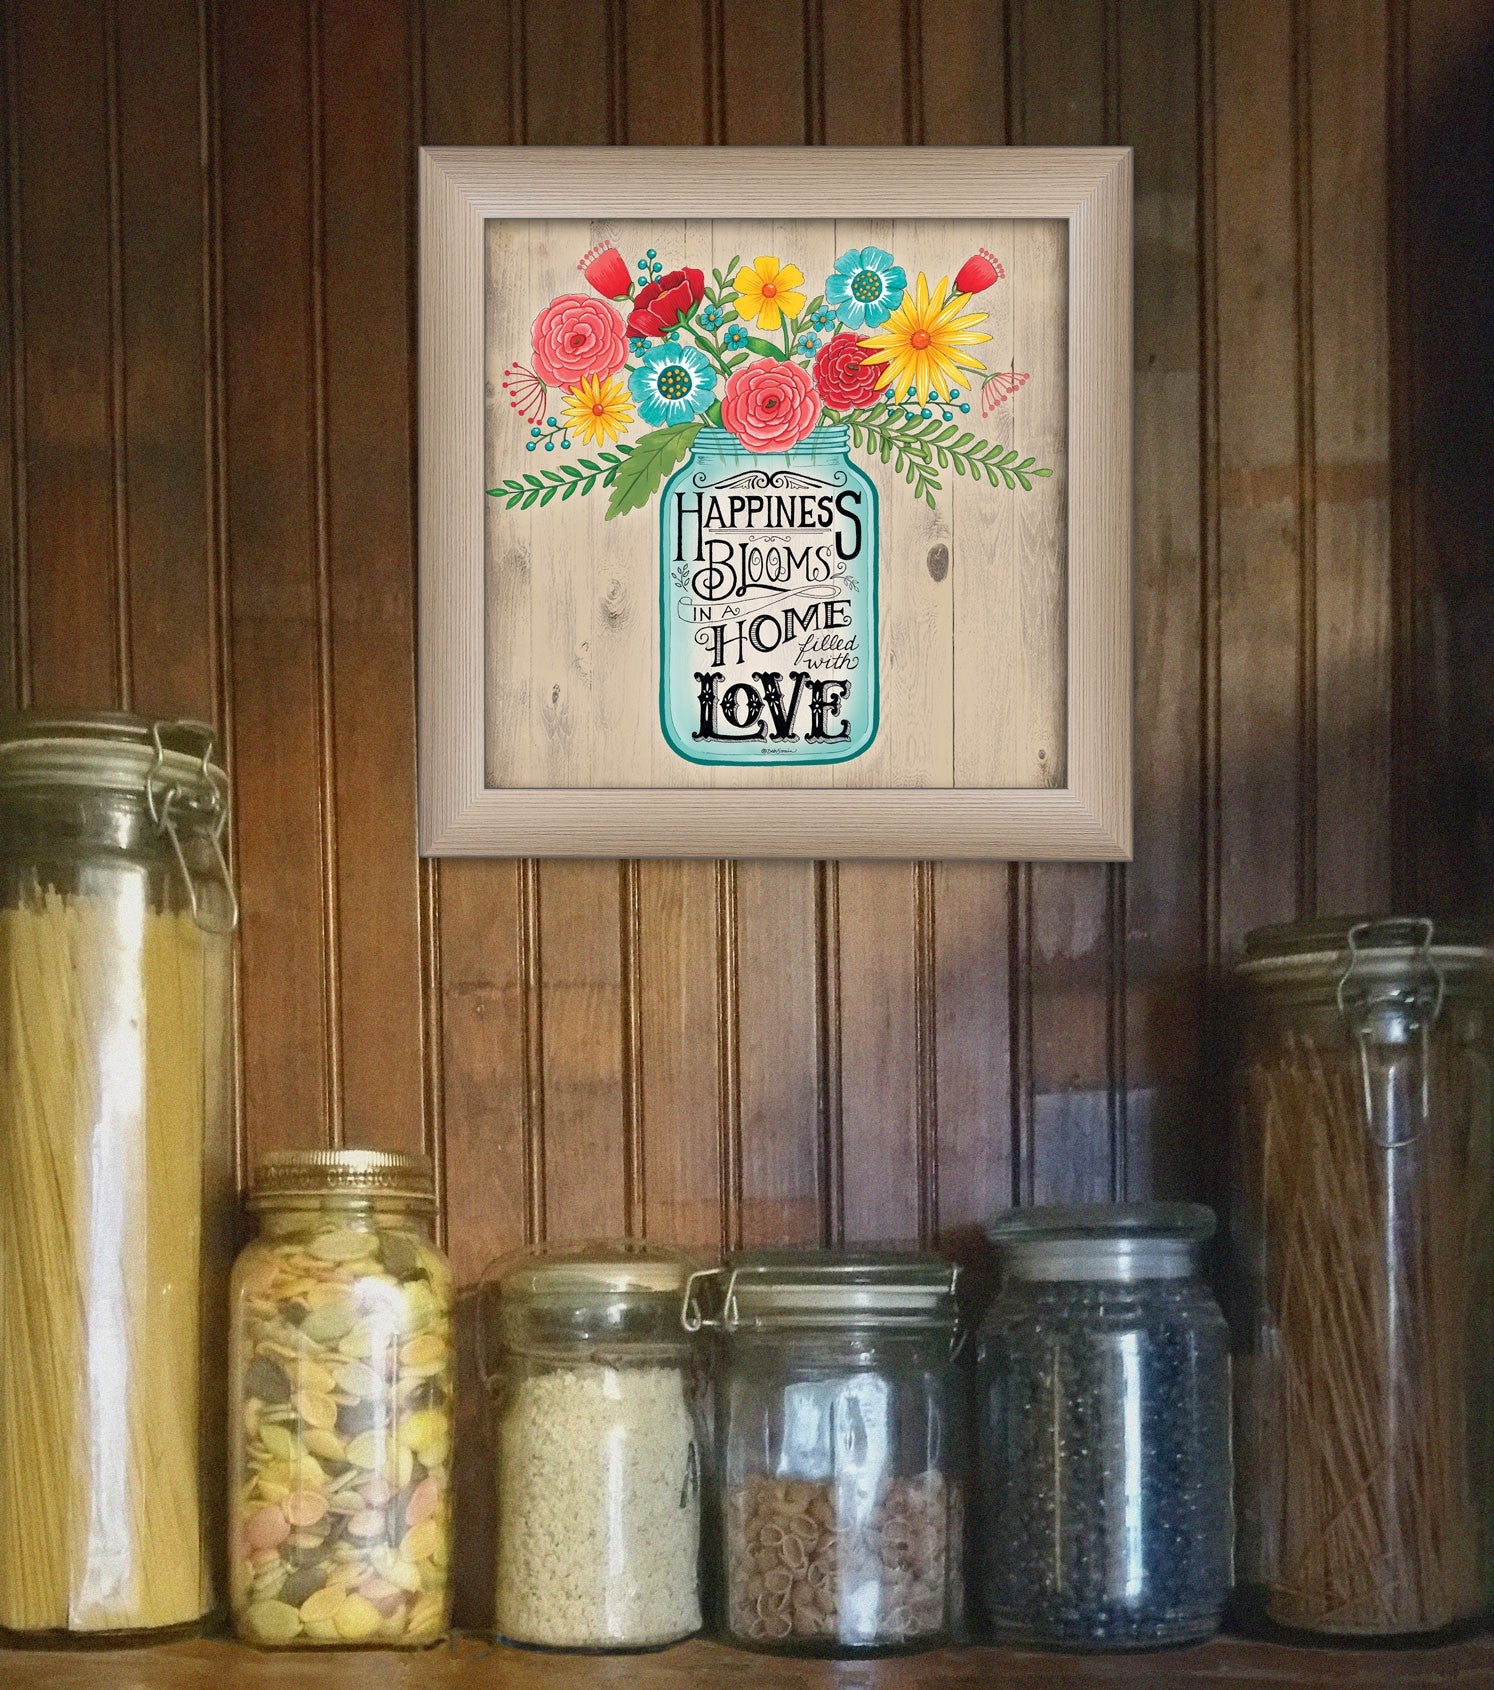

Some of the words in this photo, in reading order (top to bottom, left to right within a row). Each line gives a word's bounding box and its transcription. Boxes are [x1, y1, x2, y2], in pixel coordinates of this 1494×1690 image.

[673, 490, 862, 561] HAPPINESS
[692, 539, 833, 601] BLOOMS
[693, 605, 712, 621] IN
[721, 604, 741, 619] A
[695, 599, 852, 667] HOME
[794, 634, 859, 666] filled
[803, 652, 860, 670] with
[692, 671, 852, 744] LOVE
